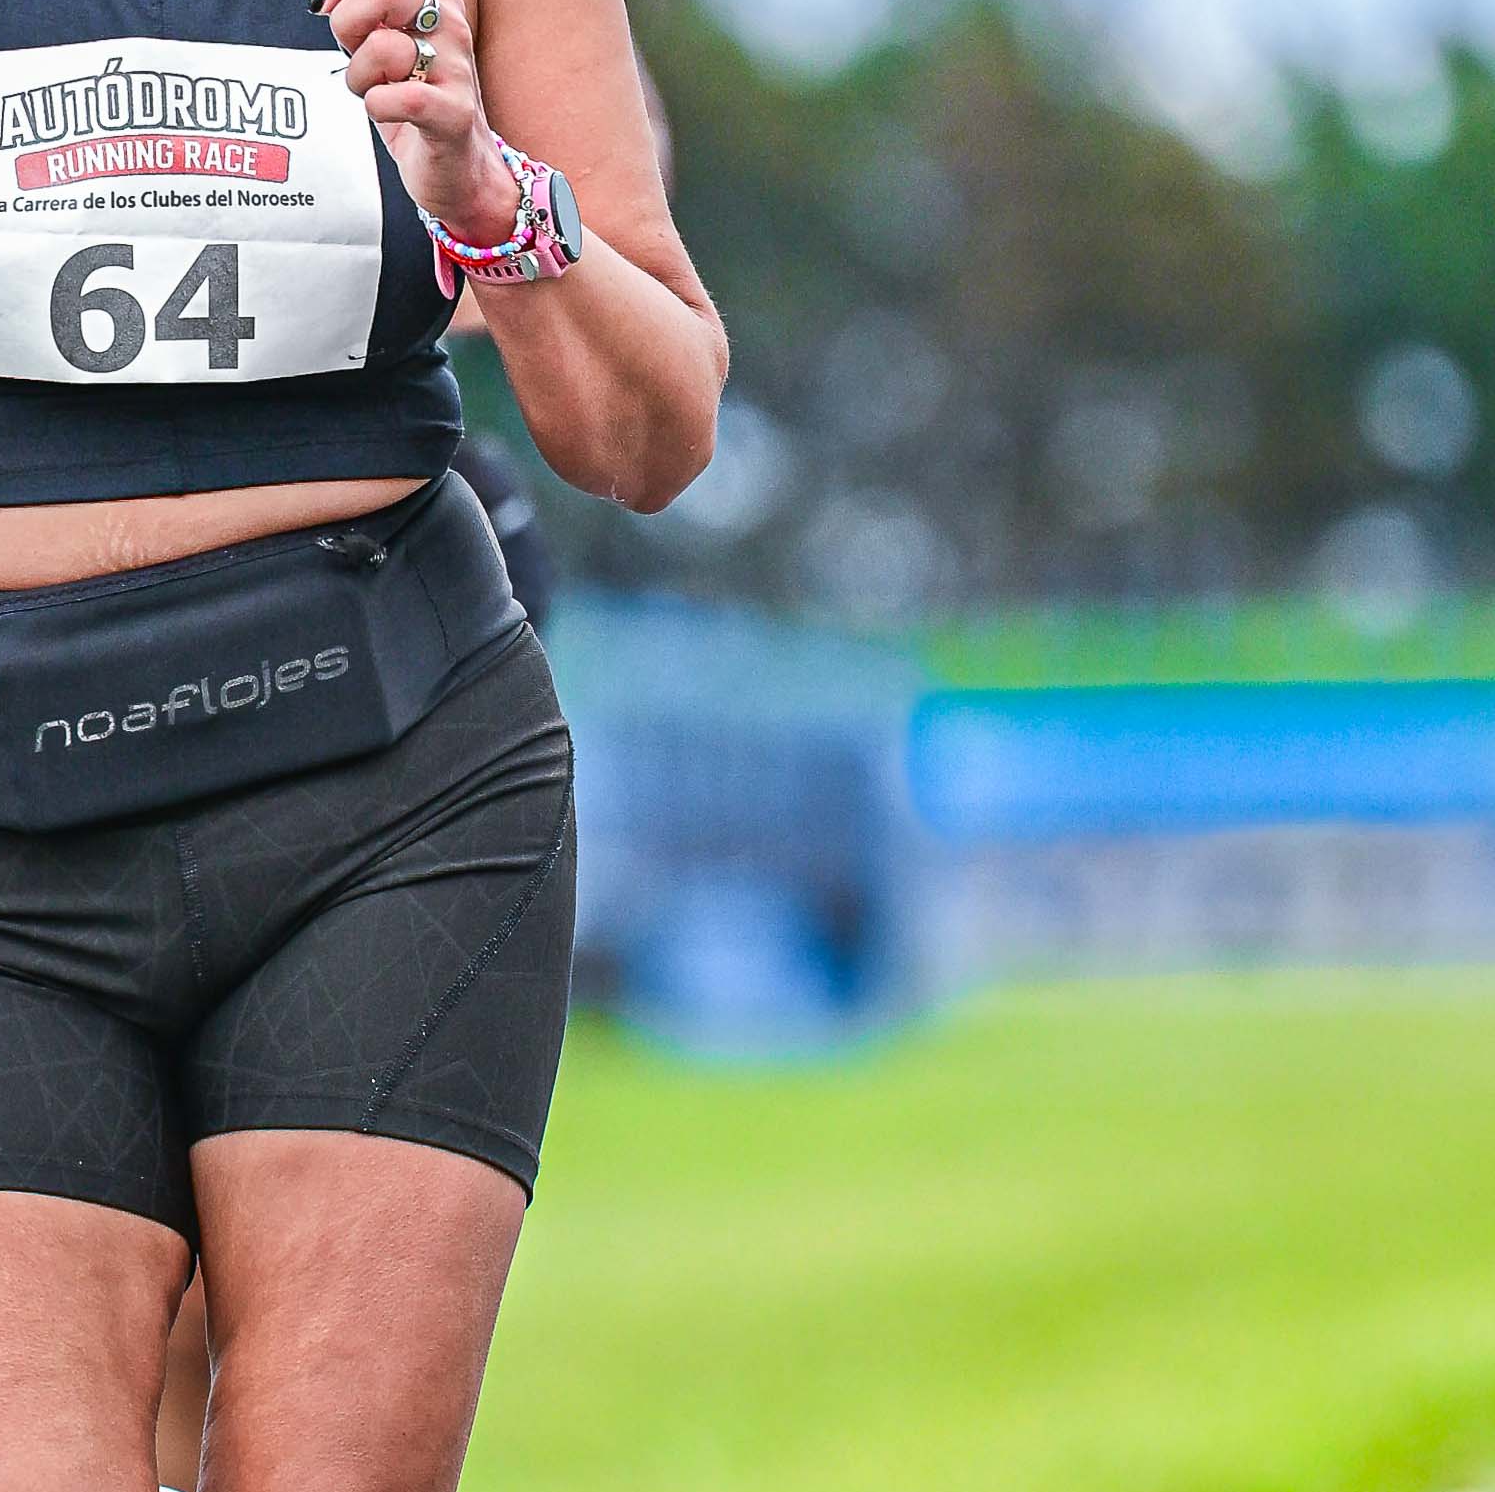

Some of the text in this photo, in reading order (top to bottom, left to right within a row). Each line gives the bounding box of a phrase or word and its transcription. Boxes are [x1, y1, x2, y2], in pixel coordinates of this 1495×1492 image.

[0, 57, 307, 150] AUTÓDROMO
[12, 196, 78, 213] Carrera
[83, 192, 106, 210] de
[110, 191, 136, 209] los
[140, 189, 201, 208] Clubes
[205, 189, 233, 207] del
[237, 189, 315, 207] Noroeste
[46, 139, 259, 185] RUNNING RACE
[49, 242, 256, 374] 64
[34, 644, 350, 754] noaflojes
